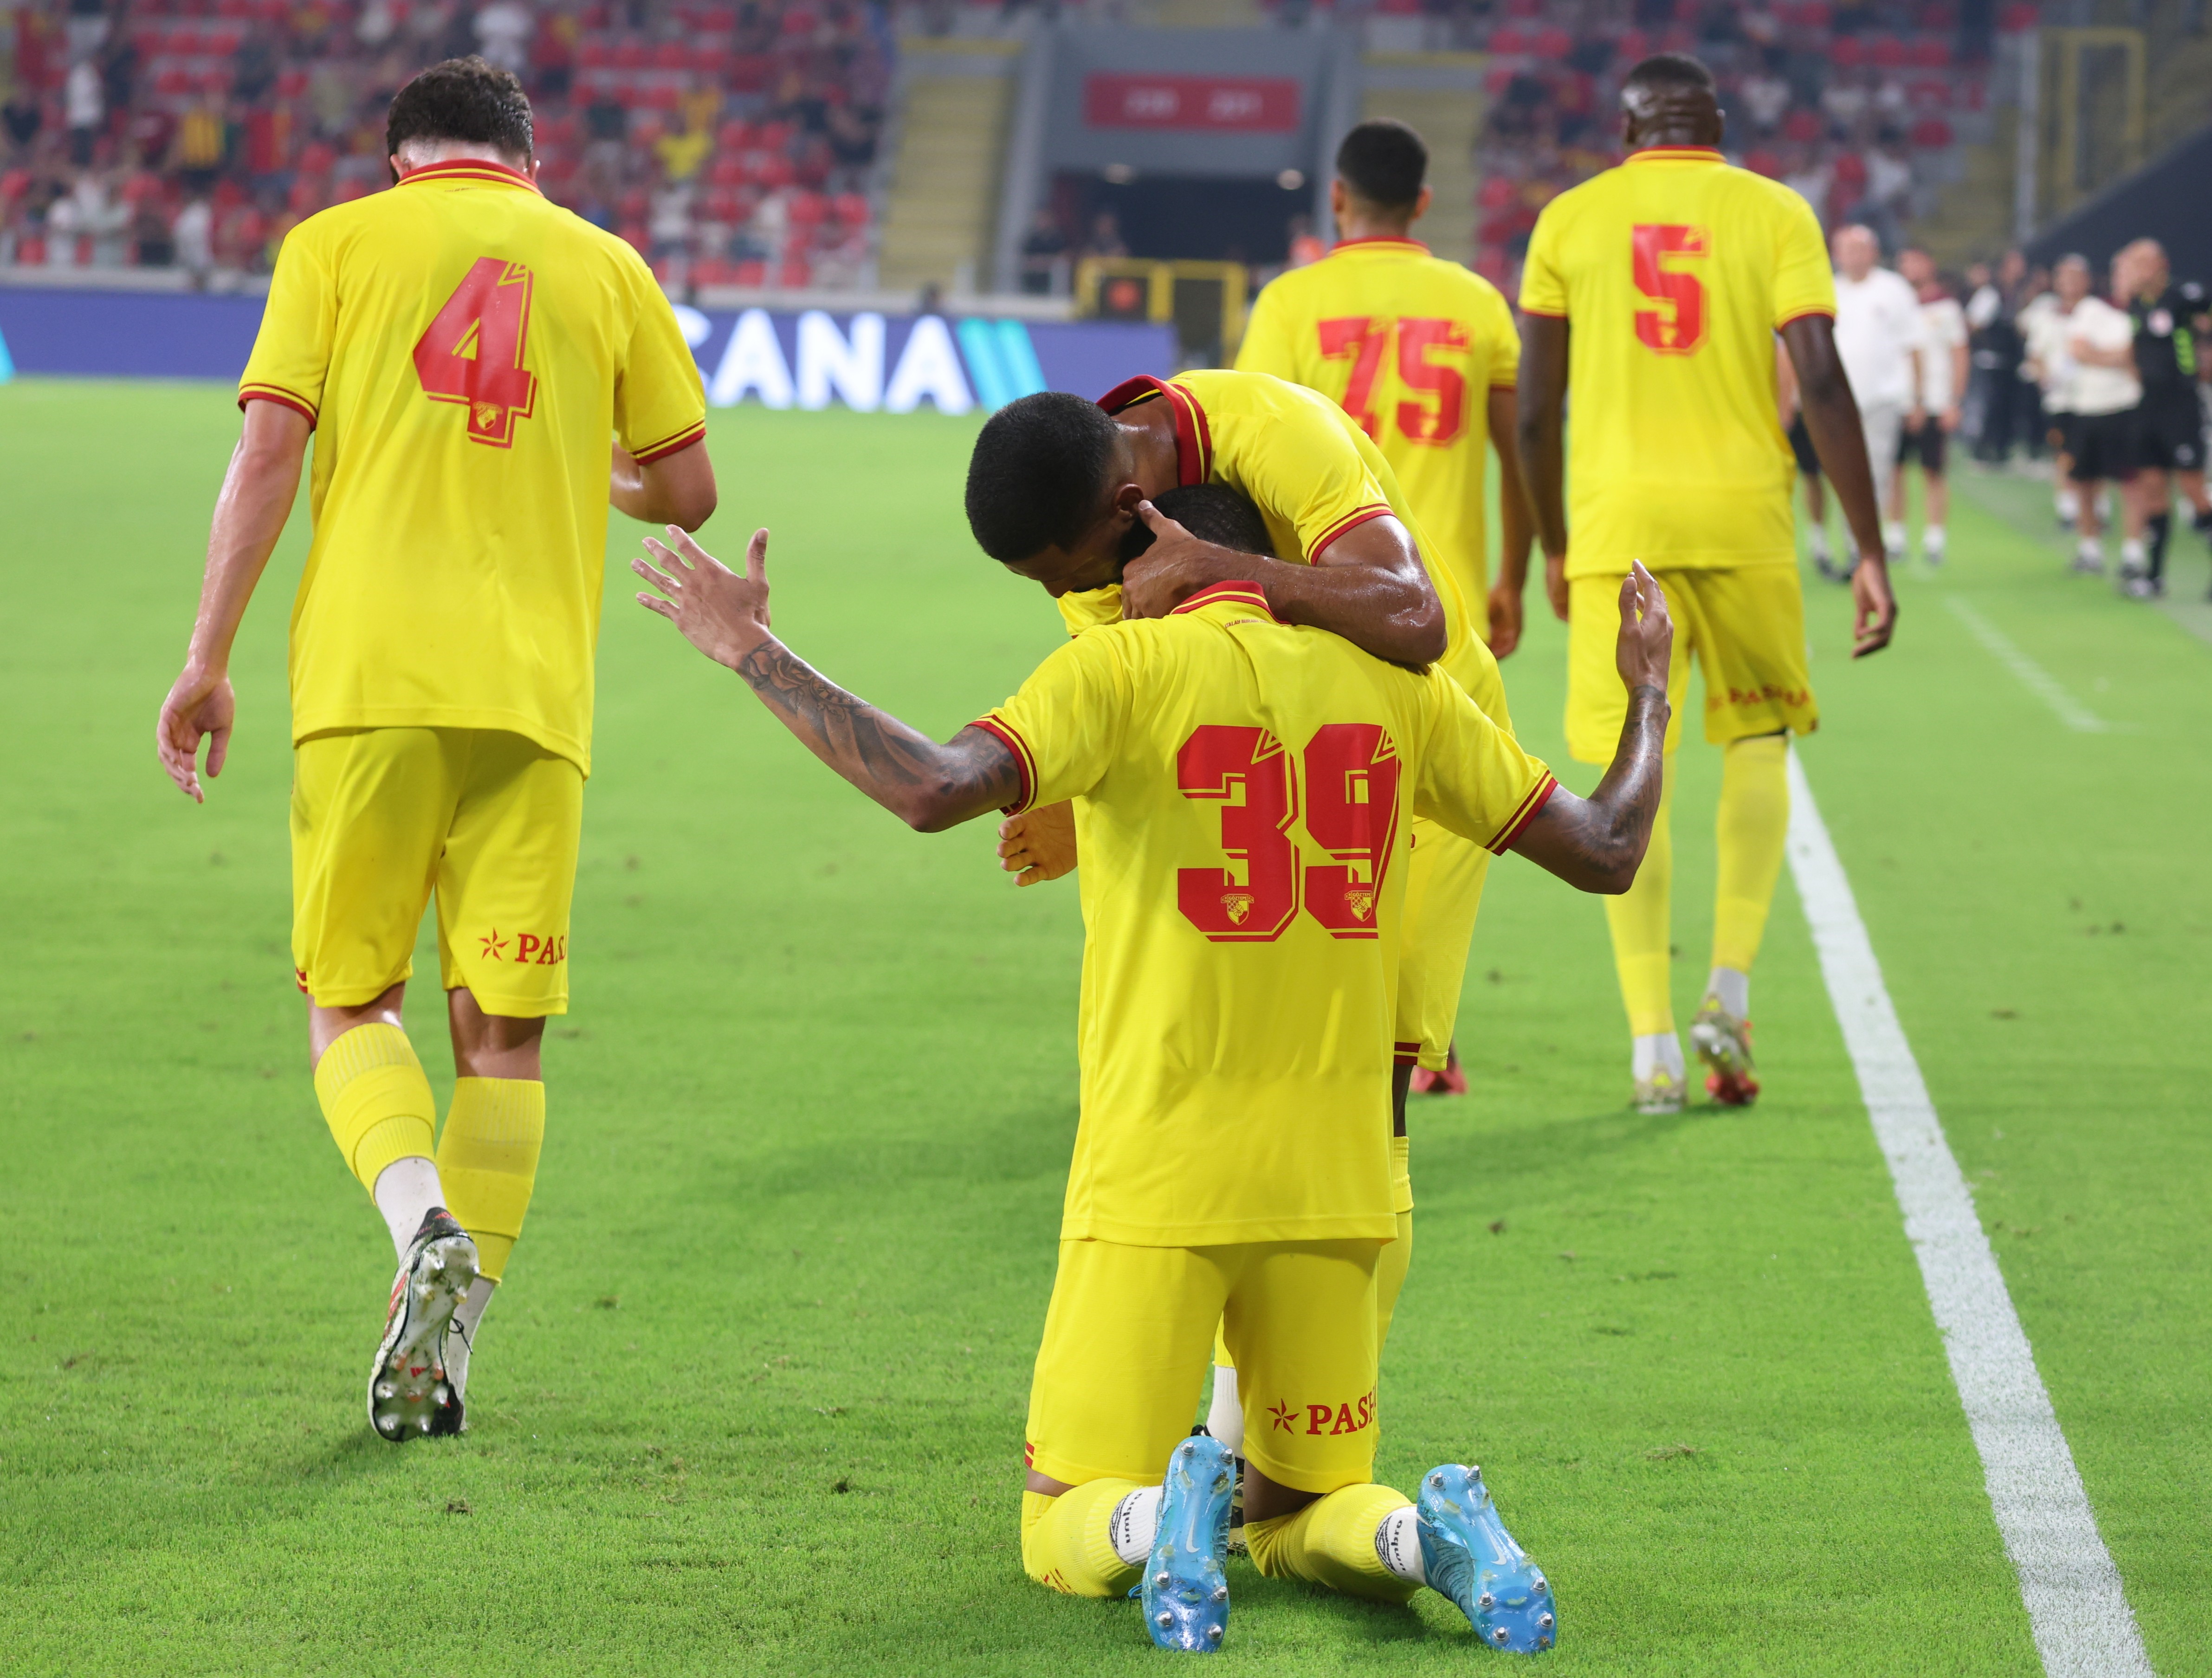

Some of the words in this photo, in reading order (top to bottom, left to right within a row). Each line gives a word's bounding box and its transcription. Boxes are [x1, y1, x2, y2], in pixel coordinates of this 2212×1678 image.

[413, 256, 537, 449] 4
[1632, 223, 1713, 359] 5
[1317, 316, 1471, 449] 75
[1177, 723, 1402, 942] 39
[1306, 1380, 1376, 1435] PASH
[1122, 1493, 1143, 1543] umbro
[1391, 1520, 1406, 1571] umbro
